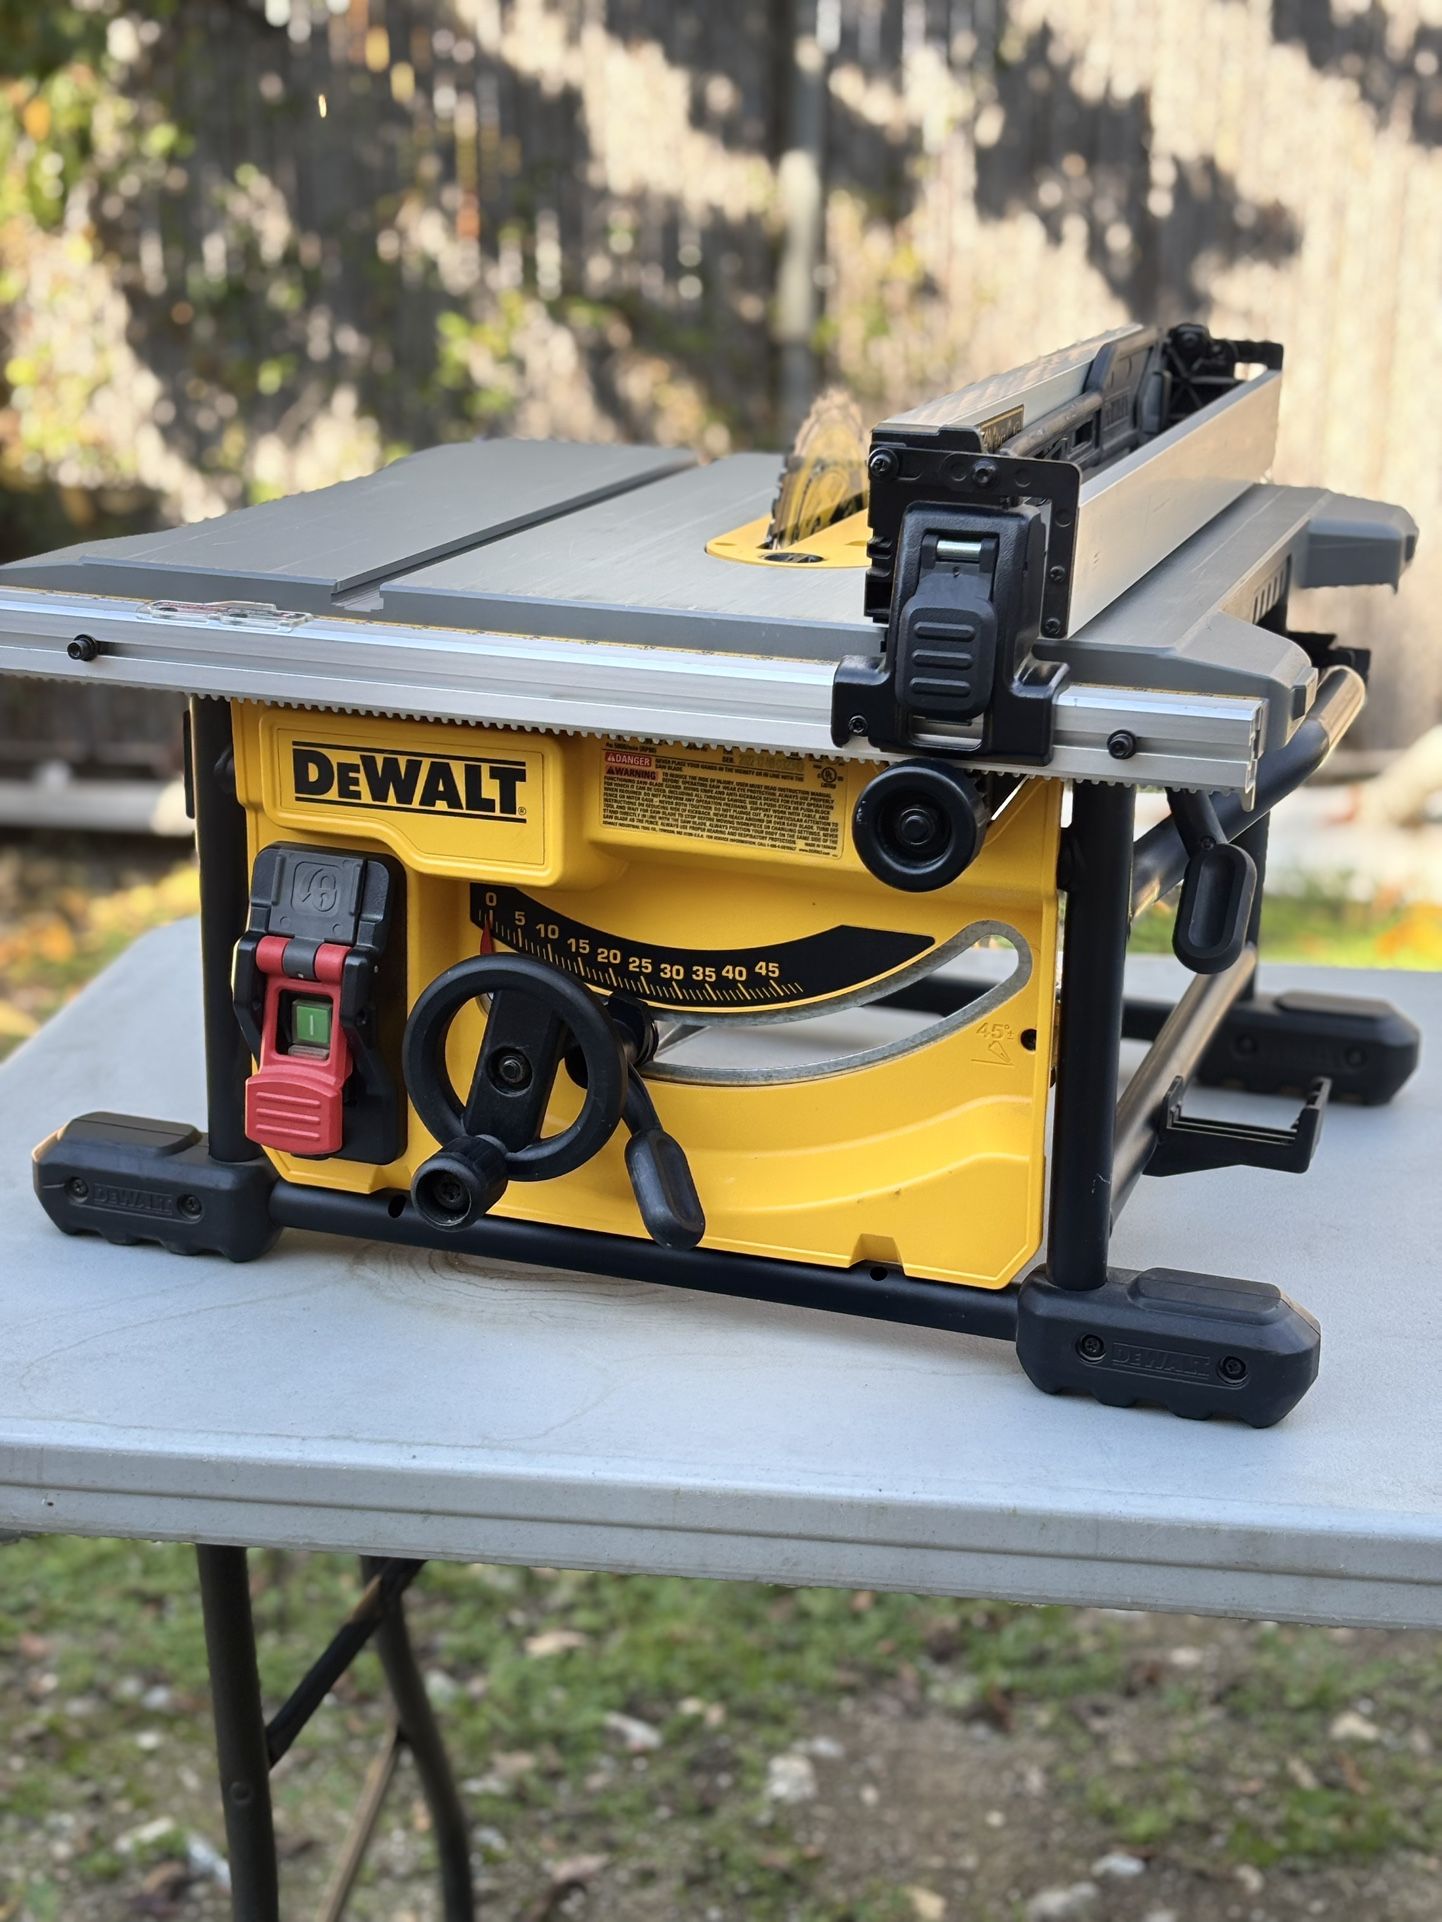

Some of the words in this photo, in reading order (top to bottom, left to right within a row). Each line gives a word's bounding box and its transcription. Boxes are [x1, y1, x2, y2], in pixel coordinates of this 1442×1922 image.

[614, 768, 656, 780] WARNING
[615, 754, 650, 766] DANGER
[293, 748, 526, 815] DEWALT
[485, 892, 496, 906] 0
[514, 911, 526, 926] 5
[535, 923, 559, 939] 10
[567, 938, 590, 953] 15
[597, 949, 621, 964] 20
[628, 957, 652, 973] 25
[660, 964, 684, 980] 30
[692, 966, 716, 982] 35
[721, 965, 747, 981] 40
[754, 961, 780, 978] 45
